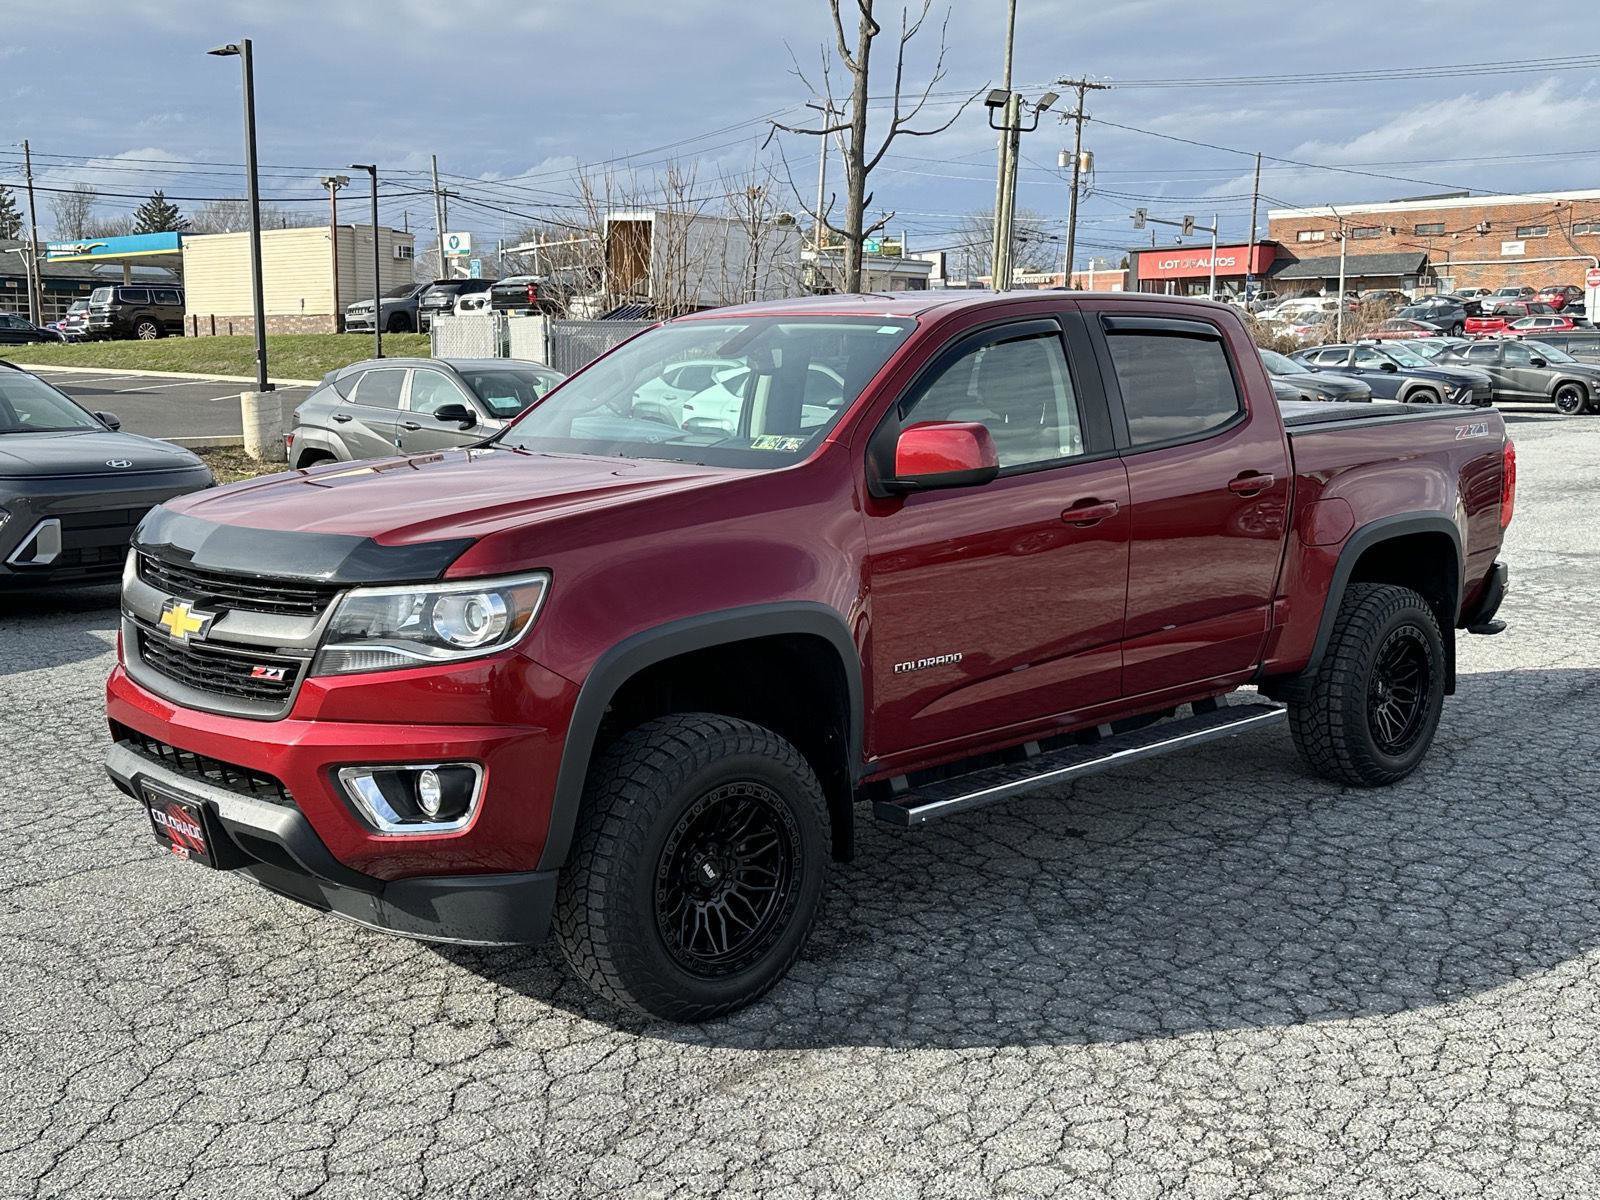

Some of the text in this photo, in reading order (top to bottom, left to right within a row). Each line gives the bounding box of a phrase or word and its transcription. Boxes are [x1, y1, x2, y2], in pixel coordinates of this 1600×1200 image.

[1158, 260, 1180, 270] LOT
[1196, 256, 1236, 268] AUTOS
[1455, 422, 1489, 441] Z71
[894, 652, 963, 674] COLORADO
[250, 665, 286, 681] Z71
[151, 808, 204, 842] COLORADO
